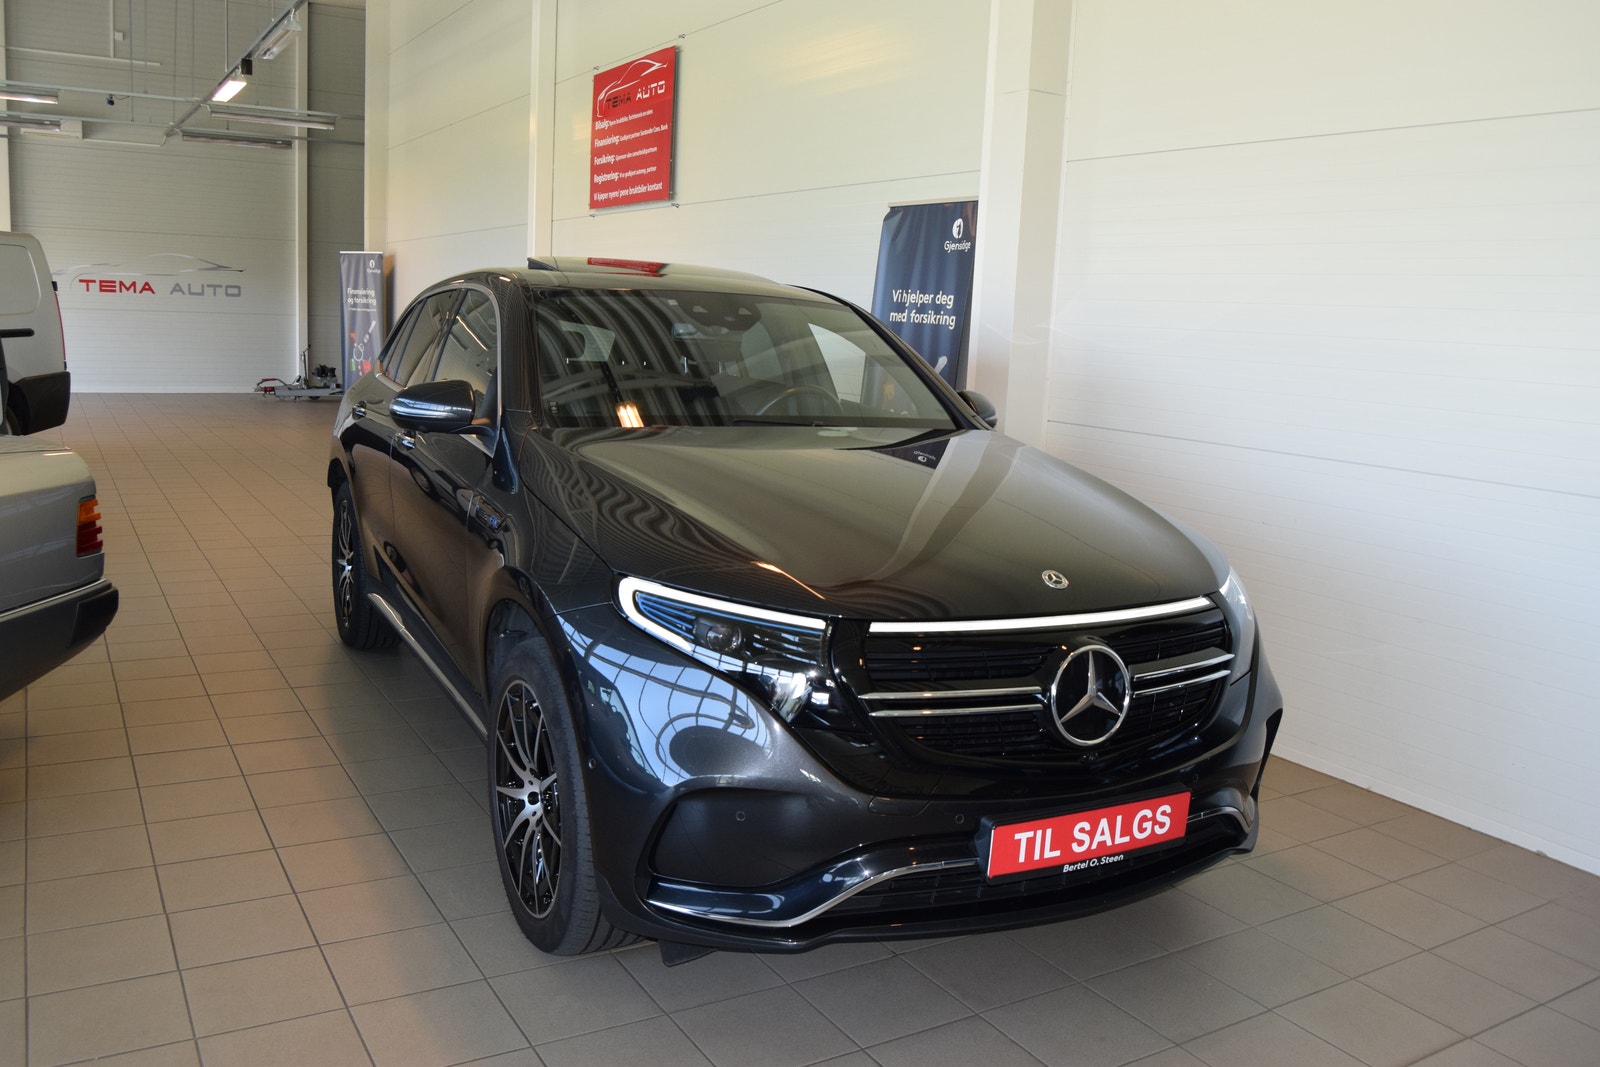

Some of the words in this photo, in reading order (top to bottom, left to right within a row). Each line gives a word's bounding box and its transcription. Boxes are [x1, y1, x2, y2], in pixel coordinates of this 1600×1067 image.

[606, 93, 631, 109] TEMA
[636, 80, 666, 101] AUTO
[595, 134, 620, 148] Finansiering:
[594, 153, 616, 165] Forsikring:
[594, 170, 620, 184] Registrering:
[79, 279, 156, 294] TEMA
[170, 283, 242, 297] AUTO
[347, 297, 354, 305] og
[354, 296, 377, 306] forsikring
[892, 290, 902, 302] Vi
[902, 290, 934, 307] hjelper
[935, 291, 955, 309] deg
[889, 309, 908, 323] med
[909, 309, 957, 330] forsikring
[1013, 828, 1061, 863] TIL
[1071, 805, 1172, 854] SALGS
[1062, 860, 1089, 873] Bertel
[1089, 858, 1100, 868] O.
[1100, 854, 1124, 865] Steen
